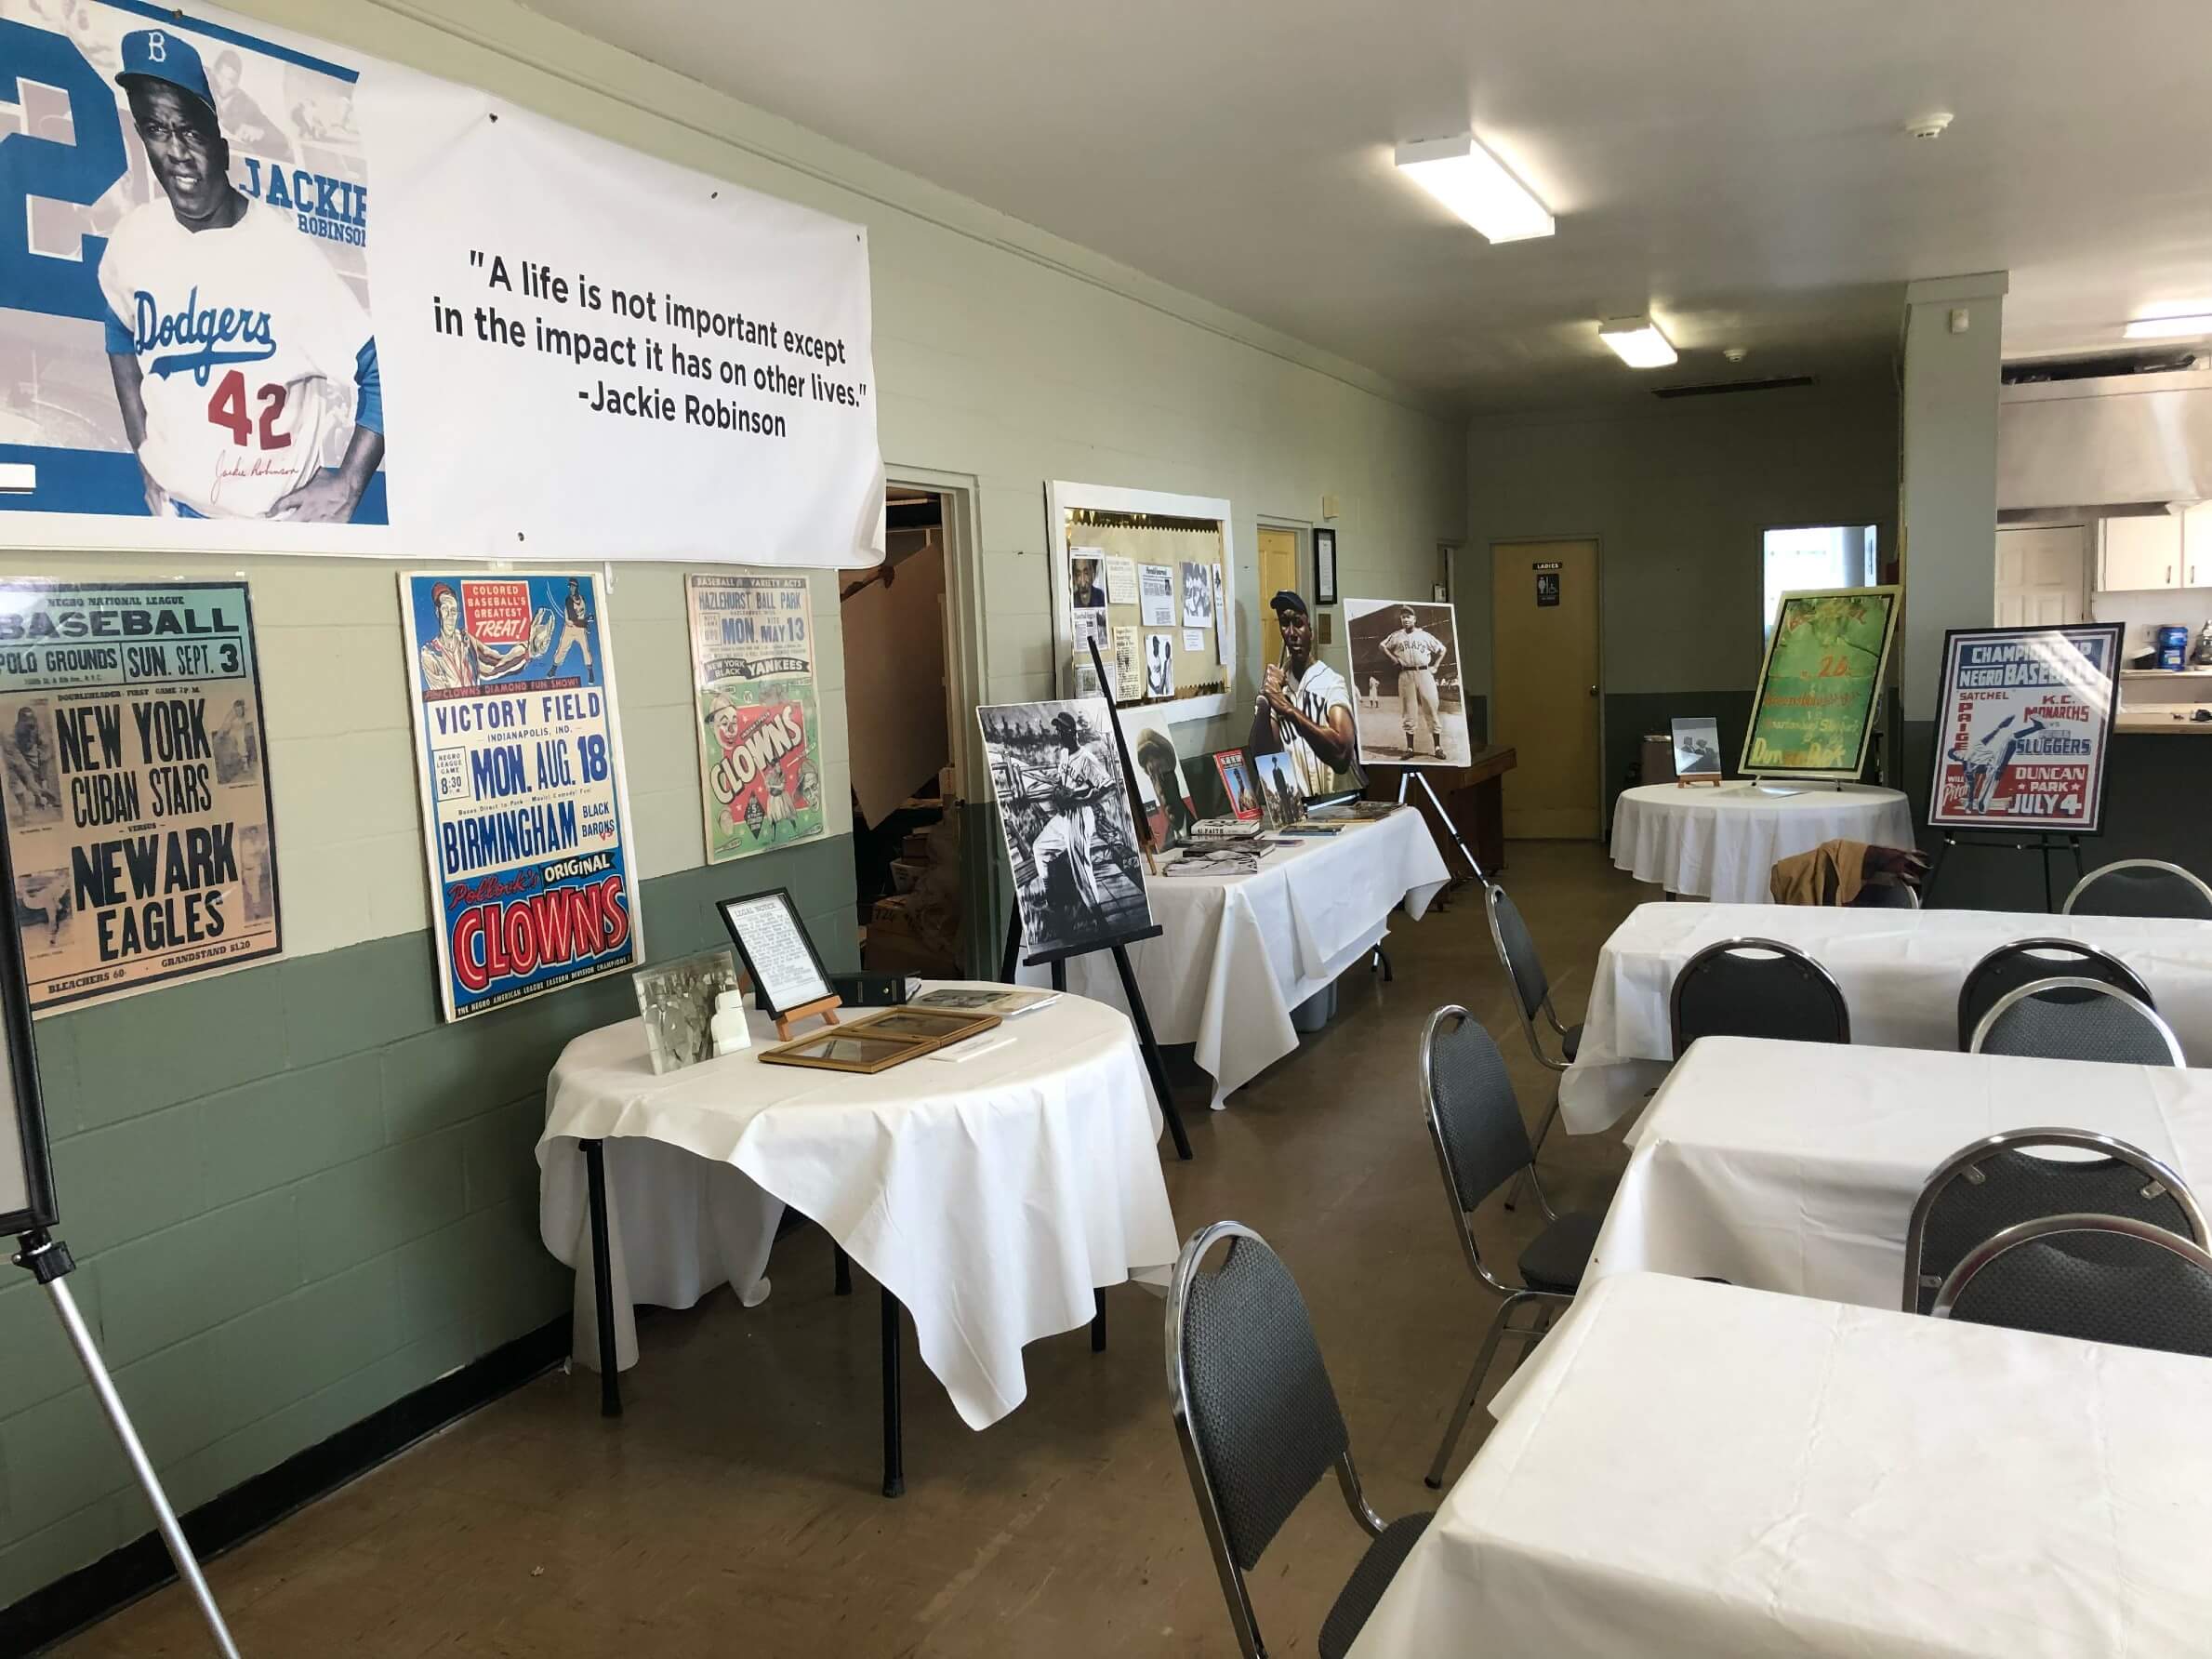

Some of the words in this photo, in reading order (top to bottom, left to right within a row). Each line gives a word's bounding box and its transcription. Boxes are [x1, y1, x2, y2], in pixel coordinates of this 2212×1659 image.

[148, 32, 166, 62] B
[239, 157, 366, 227] JACKIE
[470, 250, 512, 293] "A
[523, 260, 569, 304] life
[578, 275, 602, 311] is
[612, 289, 656, 323] not
[665, 295, 777, 351] important
[784, 329, 846, 366] except
[134, 286, 276, 387] Dodgers
[433, 297, 463, 337] in
[474, 307, 526, 348] the
[536, 317, 637, 368] impact
[645, 338, 663, 372] it
[671, 343, 712, 381] has
[720, 359, 746, 388] on
[753, 365, 805, 399] other
[810, 372, 867, 408] lives."
[207, 369, 292, 450] 42
[578, 380, 676, 422] -Jackie
[685, 393, 787, 438] Robinson
[145, 596, 185, 605] LEAGUE
[468, 596, 526, 607] BASEBALL'S
[472, 586, 519, 596] COLORED
[699, 591, 750, 610] HAZLEHURST
[756, 592, 775, 609] BALL
[781, 591, 801, 610] PARK
[0, 608, 239, 640] BASEBALL
[474, 607, 522, 619] GREATEST
[475, 617, 527, 639] TREAT!
[722, 617, 758, 644] MON.
[761, 625, 785, 643] MAY
[788, 617, 805, 641] 13
[46, 648, 118, 672] GROUNDS
[129, 646, 172, 678] SUN.
[178, 644, 214, 675] SEPT.
[219, 643, 239, 672] 3
[708, 661, 722, 670] NEW
[724, 659, 745, 668] YORK
[1971, 642, 2093, 664] CHAMPIP
[715, 669, 741, 677] BLACK
[748, 658, 803, 676] YANKEES
[1960, 669, 2003, 686] NEGRO
[2004, 659, 2094, 685] BASEB
[443, 687, 481, 699] CLOWNS
[485, 682, 526, 695] DIAMOND
[531, 681, 549, 690] FUN
[550, 678, 578, 688] SHOW!
[1959, 691, 2009, 701] SATCHEL
[435, 698, 527, 735] VICTORY
[543, 692, 601, 723] FIELD
[2023, 705, 2090, 723] MONARCHS
[55, 704, 122, 774] NEW
[132, 698, 212, 764] YORK
[555, 724, 573, 735] IND.
[1954, 702, 1973, 750] PAIGE
[710, 706, 802, 804] CLOWNS
[2016, 738, 2091, 755] SLUGGERS
[437, 760, 461, 768] LEAGUE
[470, 744, 533, 801] MON.
[536, 738, 576, 790] AUG.
[577, 734, 608, 784] 18
[2015, 766, 2085, 780] DUNCAN
[441, 776, 462, 794] 8:30
[1947, 776, 1965, 784] WILL
[2030, 781, 2069, 792] PARK
[71, 771, 140, 828] CUBAN
[149, 763, 212, 817] STARS
[2008, 793, 2059, 815] JULY
[2060, 793, 2083, 815] 4
[582, 802, 610, 818] BLACK
[443, 801, 578, 875] BIRMINGHAM
[581, 819, 615, 838] BARONS
[71, 822, 238, 911] NEWARK
[544, 853, 610, 883] ORIGINAL
[97, 890, 225, 962] EAGLES
[453, 876, 632, 991] CLOWNS
[162, 946, 226, 968] GRANDSTAND
[48, 973, 110, 994] BLEACHERS
[457, 1007, 470, 1016] THE
[471, 1000, 491, 1012] NEGRO
[493, 989, 522, 1004] AMERICAN
[523, 983, 544, 995] LEAGUE
[546, 975, 570, 989] EASTERN
[572, 967, 595, 981] DIVISION
